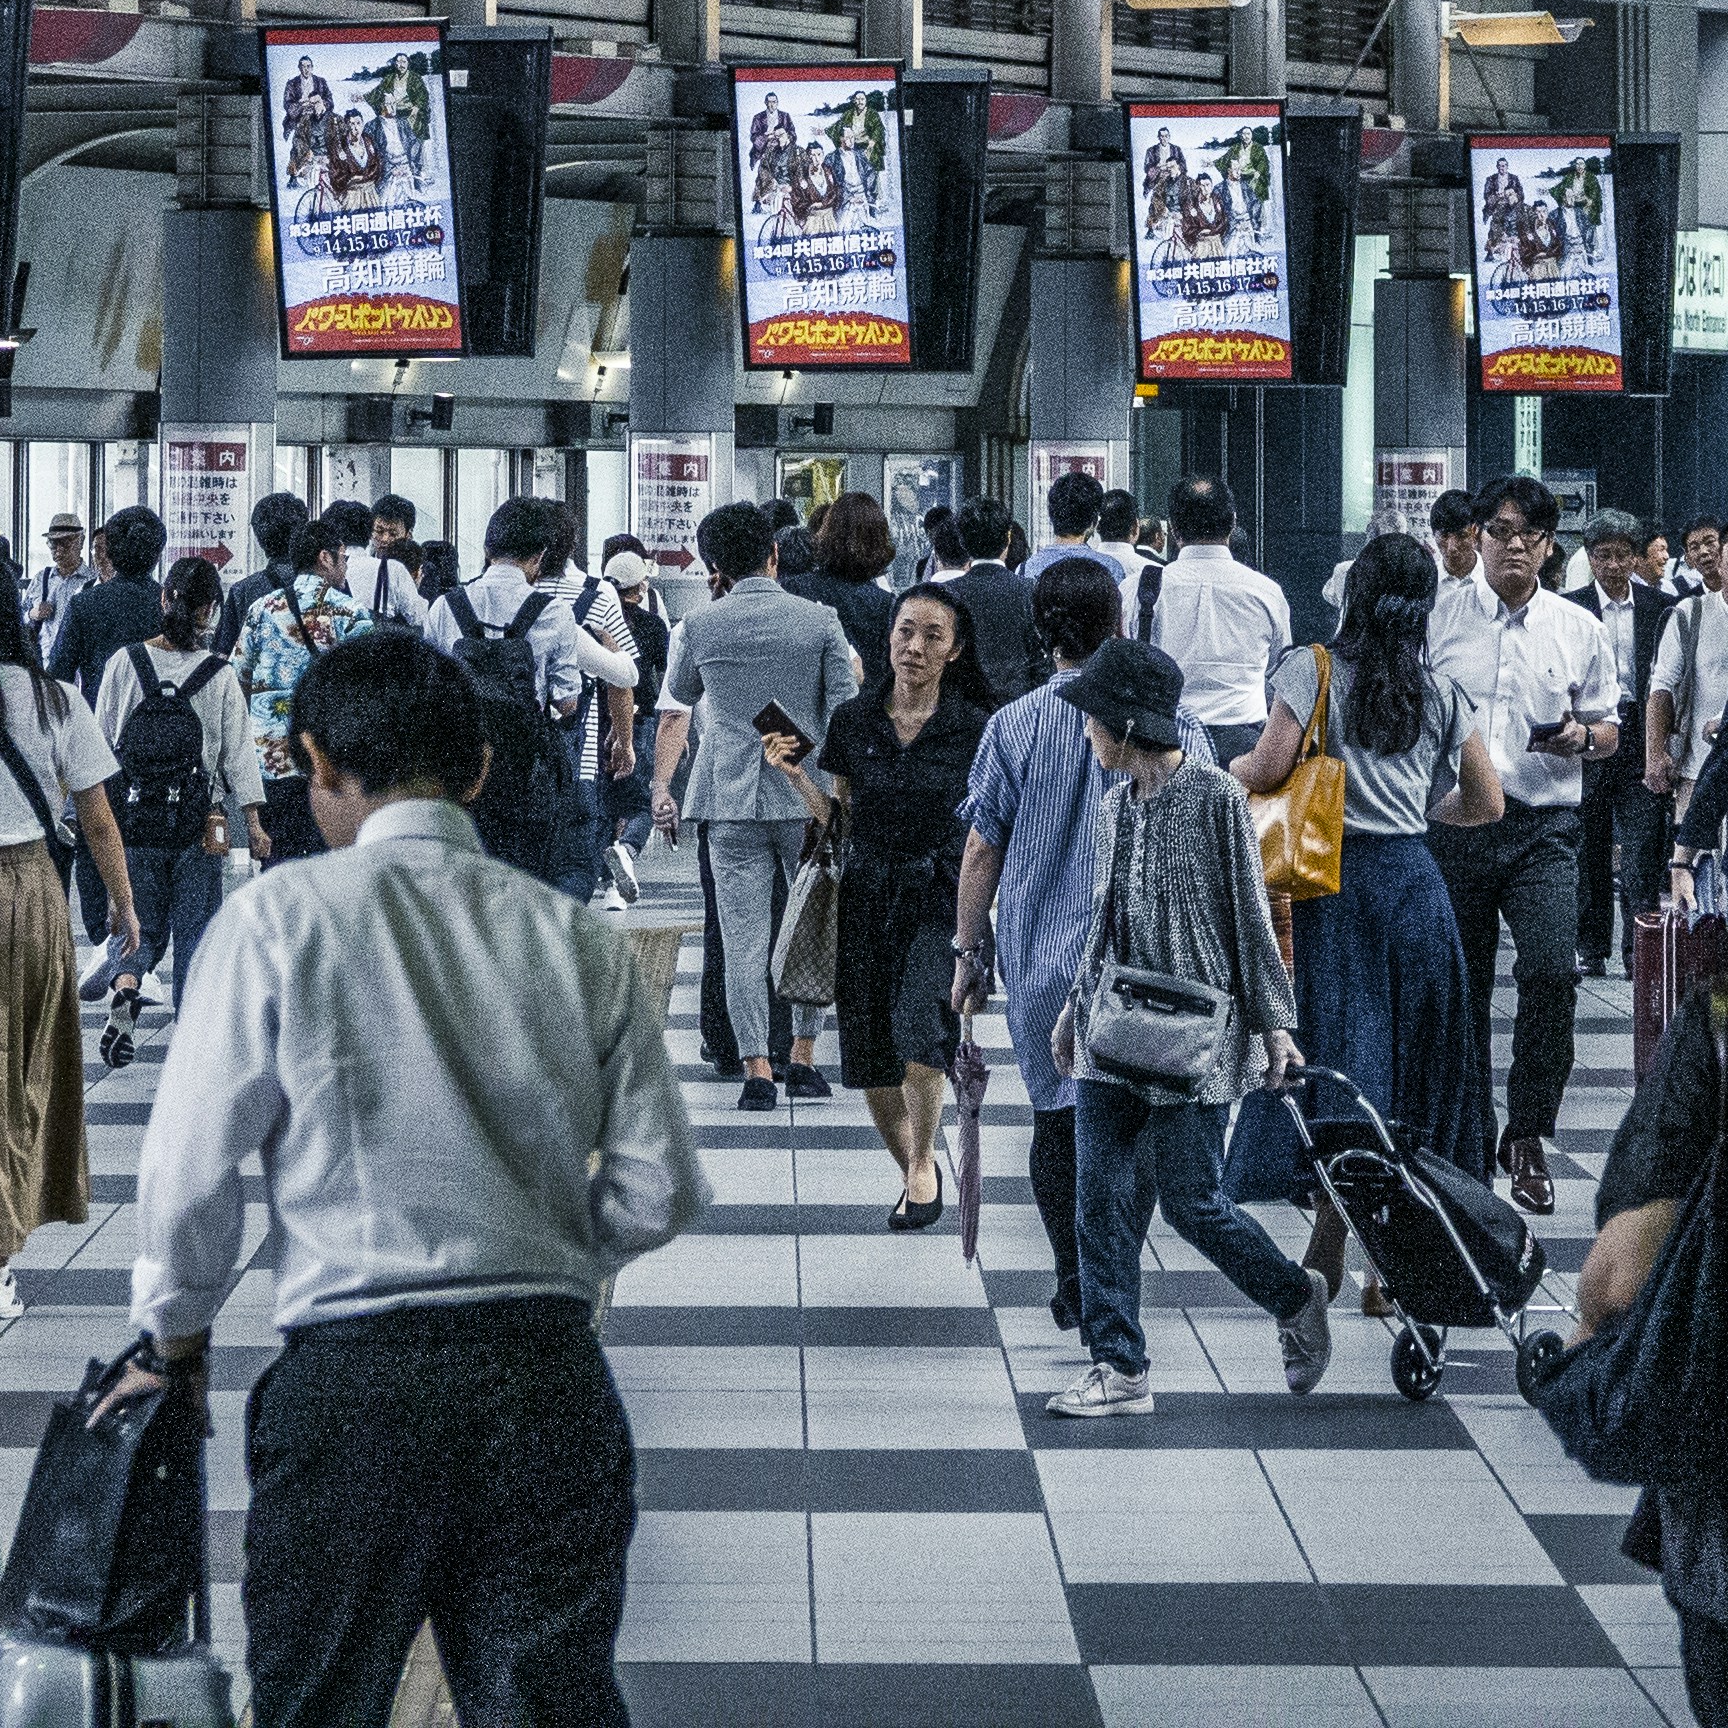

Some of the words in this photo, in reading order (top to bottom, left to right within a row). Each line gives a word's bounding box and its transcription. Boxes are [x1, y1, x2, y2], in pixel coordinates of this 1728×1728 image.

[289, 221, 332, 238] 第34回
[333, 205, 444, 236] 共同通信社杯
[322, 251, 445, 293] 高知競輪
